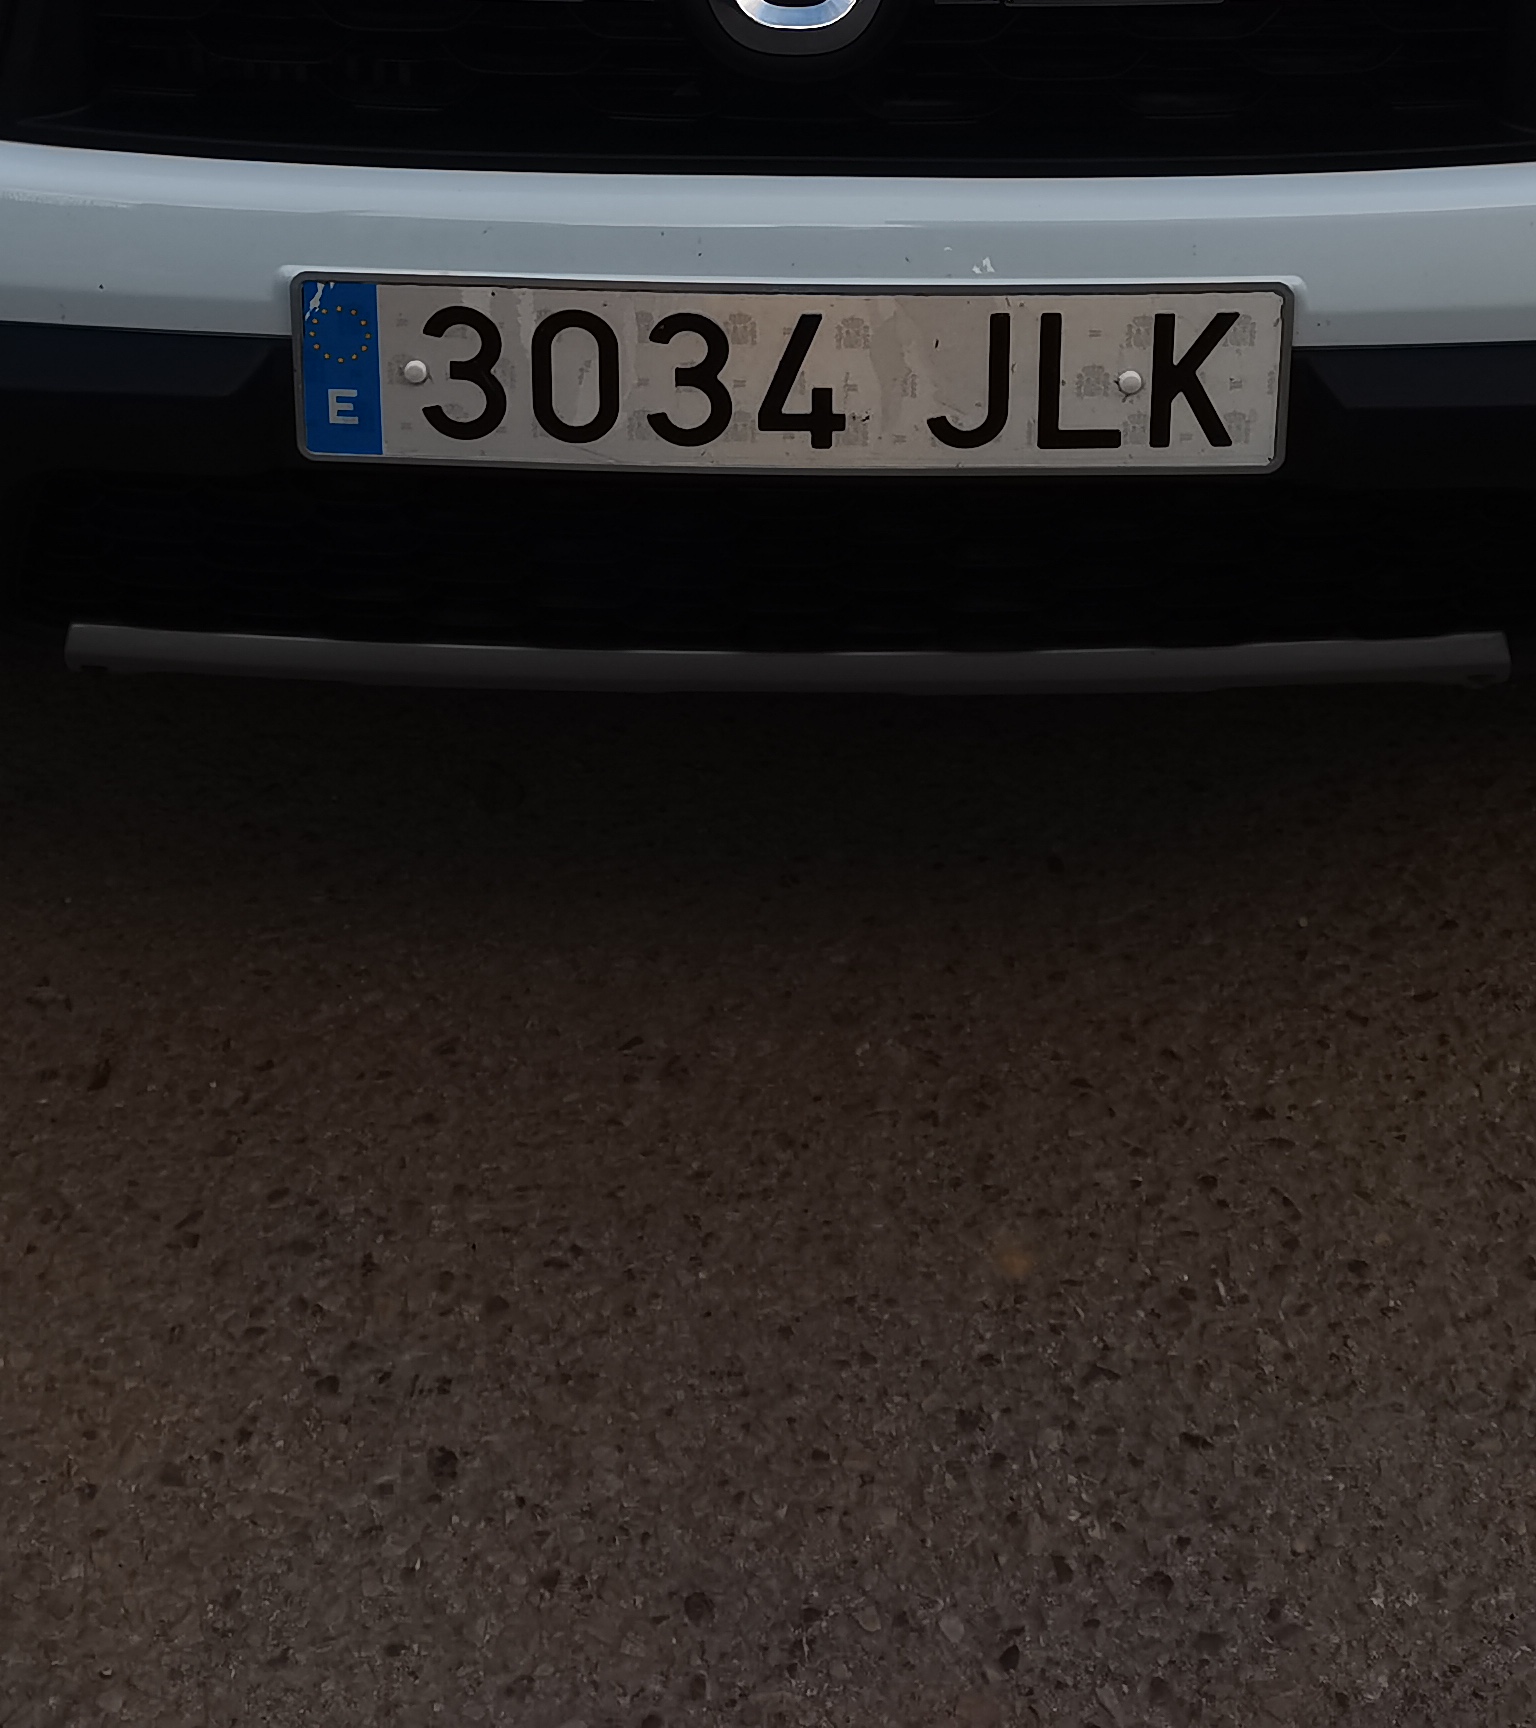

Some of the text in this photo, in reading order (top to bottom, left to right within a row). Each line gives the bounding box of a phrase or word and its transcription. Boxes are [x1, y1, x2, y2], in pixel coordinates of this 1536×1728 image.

[326, 387, 360, 425] E
[421, 304, 1242, 451] 3034 JLK
